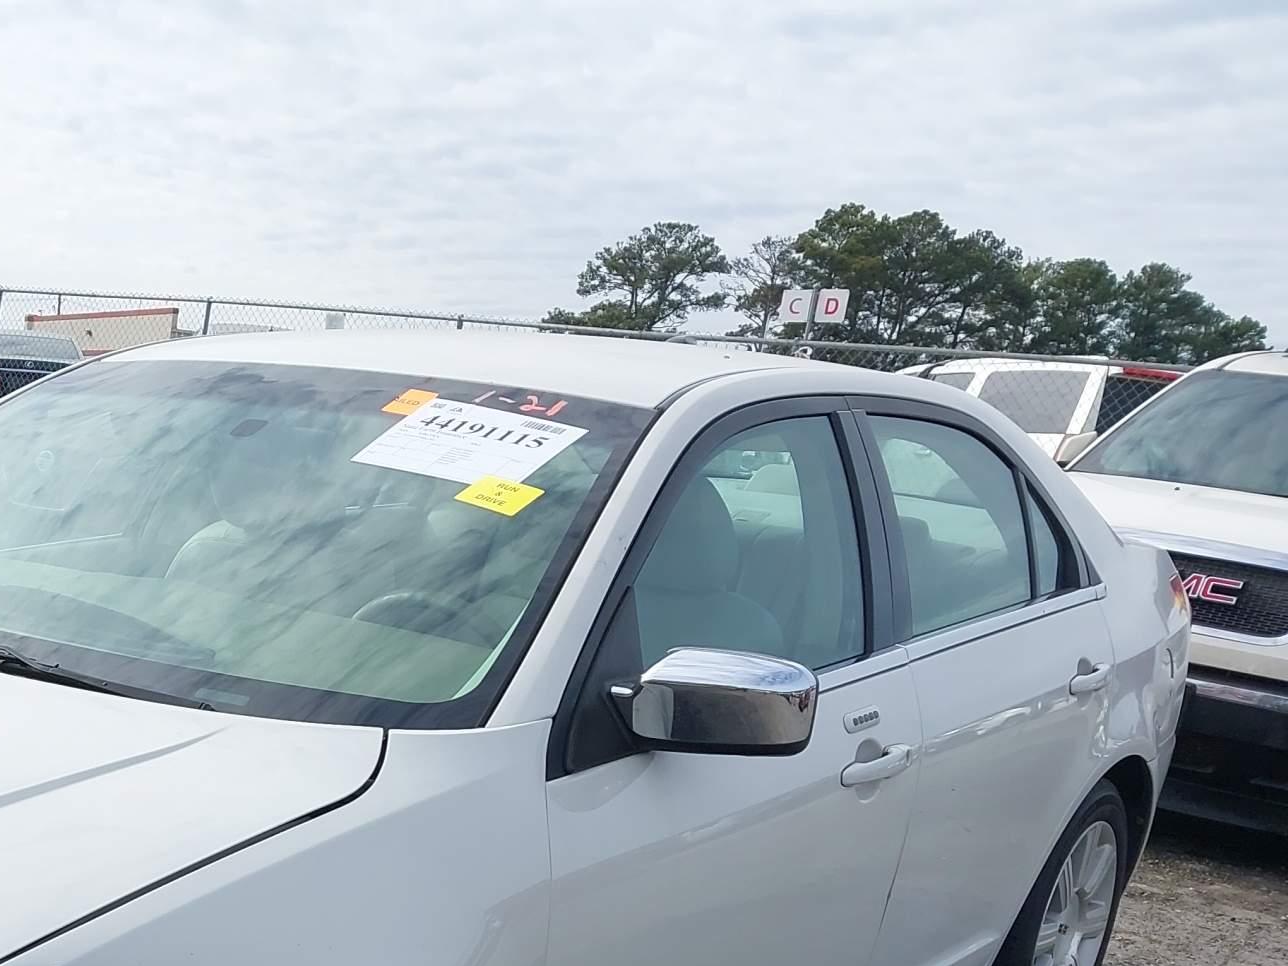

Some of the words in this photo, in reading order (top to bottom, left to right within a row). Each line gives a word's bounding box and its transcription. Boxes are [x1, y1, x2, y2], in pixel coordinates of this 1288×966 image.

[789, 297, 803, 314] C
[824, 297, 839, 315] D
[419, 414, 551, 450] 44191115
[496, 482, 521, 493] RUN
[474, 493, 507, 507] DRIVE
[1181, 572, 1244, 605] MC
